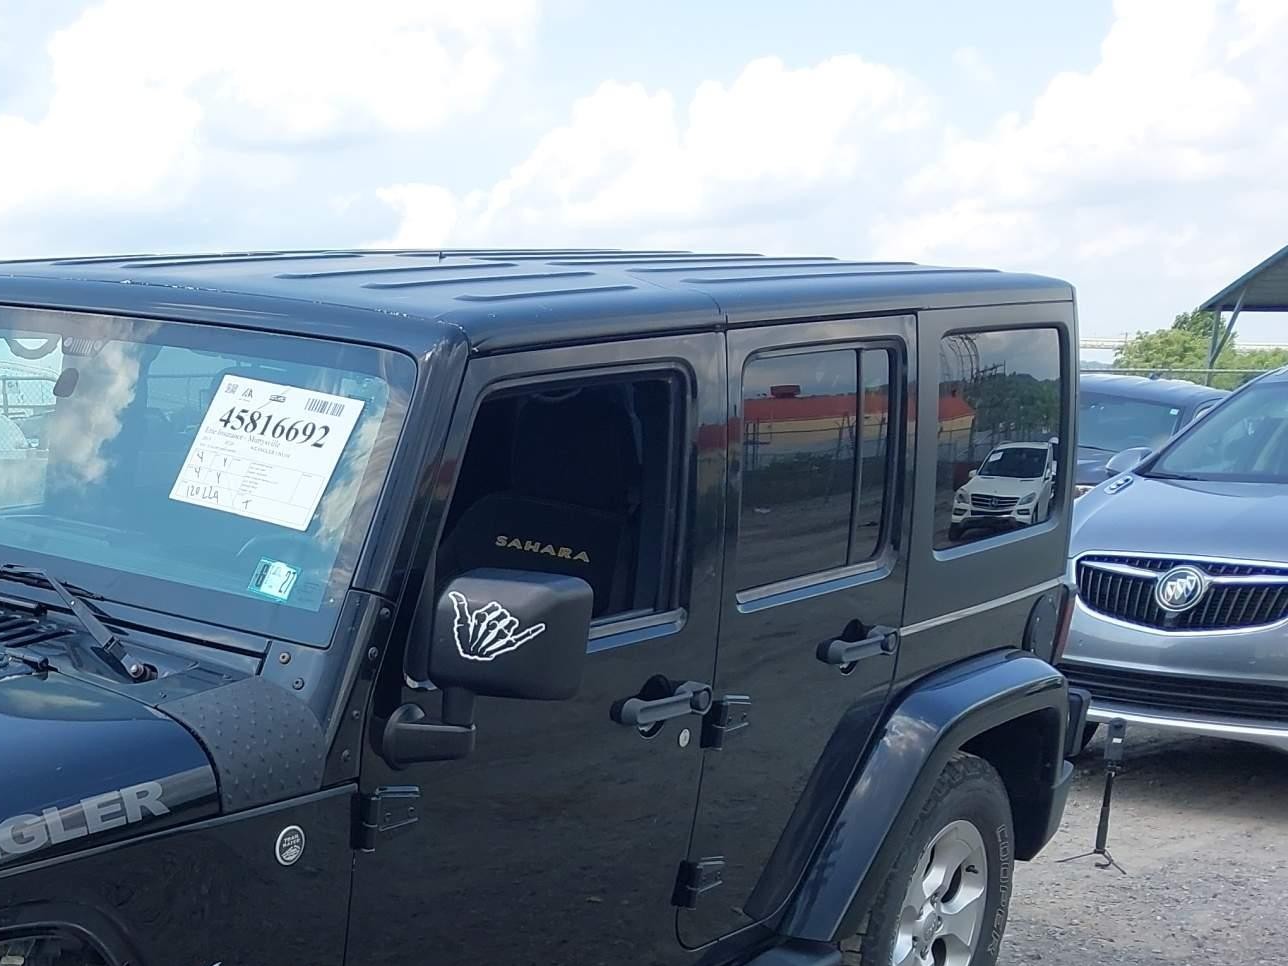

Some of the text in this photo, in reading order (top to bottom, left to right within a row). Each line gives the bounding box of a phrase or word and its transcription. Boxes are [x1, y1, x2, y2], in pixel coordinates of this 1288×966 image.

[219, 406, 330, 448] 45816692
[495, 535, 590, 563] SAHARA
[278, 570, 297, 594] 27
